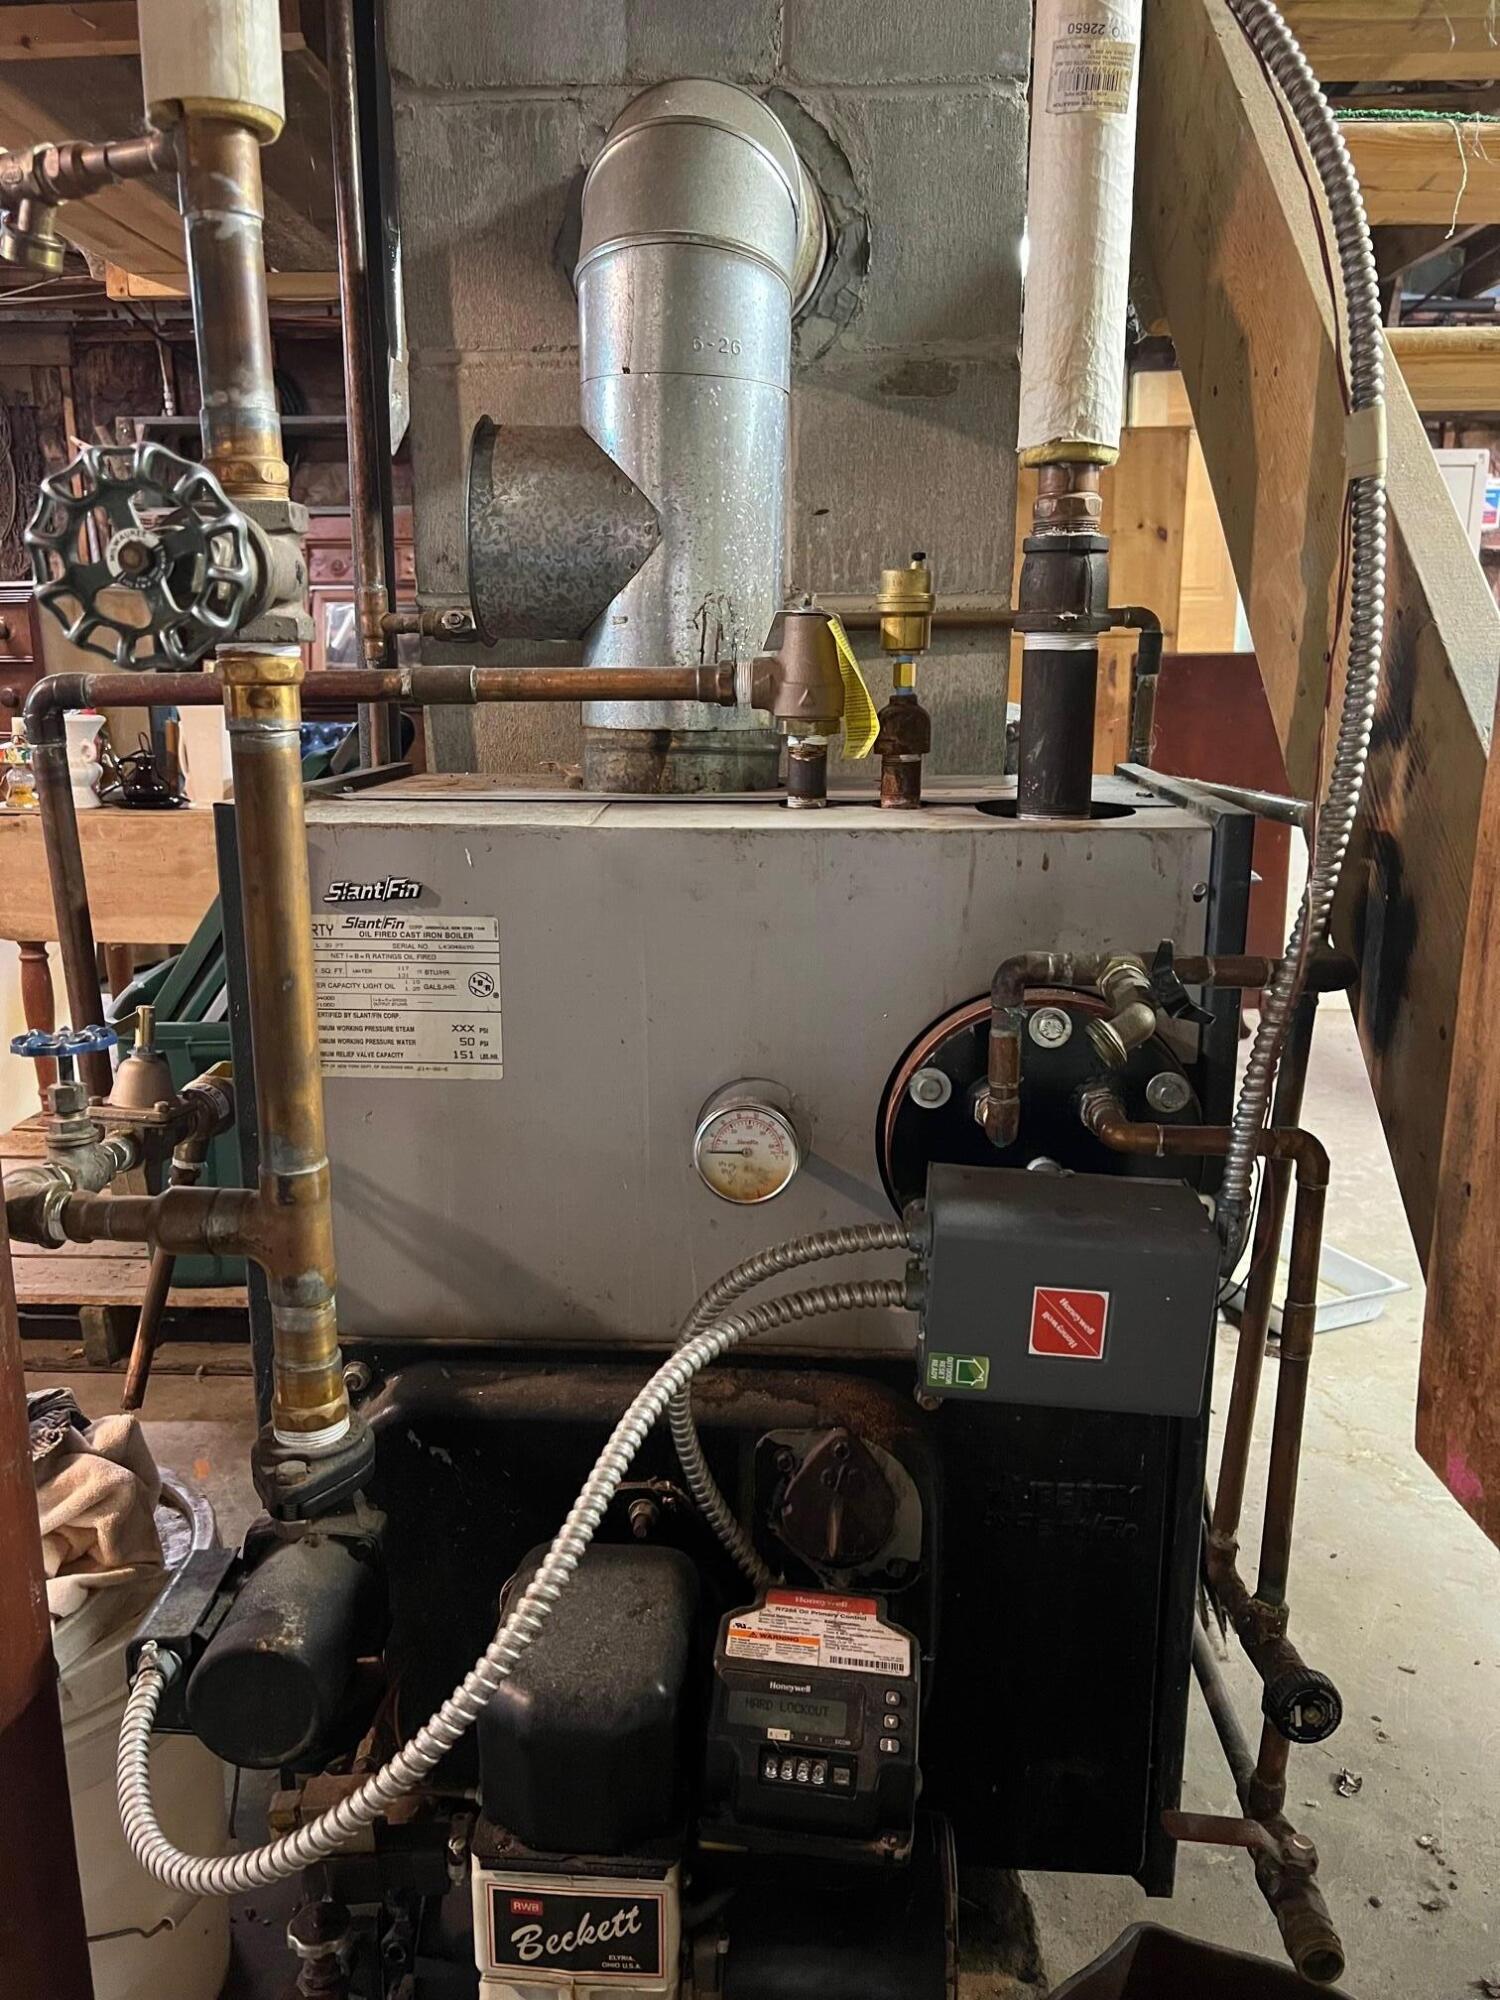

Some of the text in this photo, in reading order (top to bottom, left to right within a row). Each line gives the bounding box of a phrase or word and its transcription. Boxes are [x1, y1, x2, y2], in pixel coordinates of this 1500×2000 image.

[1067, 22, 1105, 35] 22650
[692, 336, 742, 355] 6-26
[323, 875, 421, 901] Slant/Fin
[312, 915, 405, 936] RTY Slant/Fin
[359, 930, 372, 938] OIL
[451, 1024, 475, 1032] XXX
[459, 1037, 475, 1046] 50
[453, 1050, 474, 1059] 151
[794, 1596, 849, 1609] Honeywell
[811, 1609, 839, 1618] Primary
[840, 1613, 867, 1621] Control
[760, 1631, 800, 1643] WARNING
[769, 1681, 812, 1693] Honeywell
[745, 1696, 830, 1717] HARD LOCKOUT
[513, 1901, 540, 1912] RWB
[510, 1904, 642, 1961] Beckett
